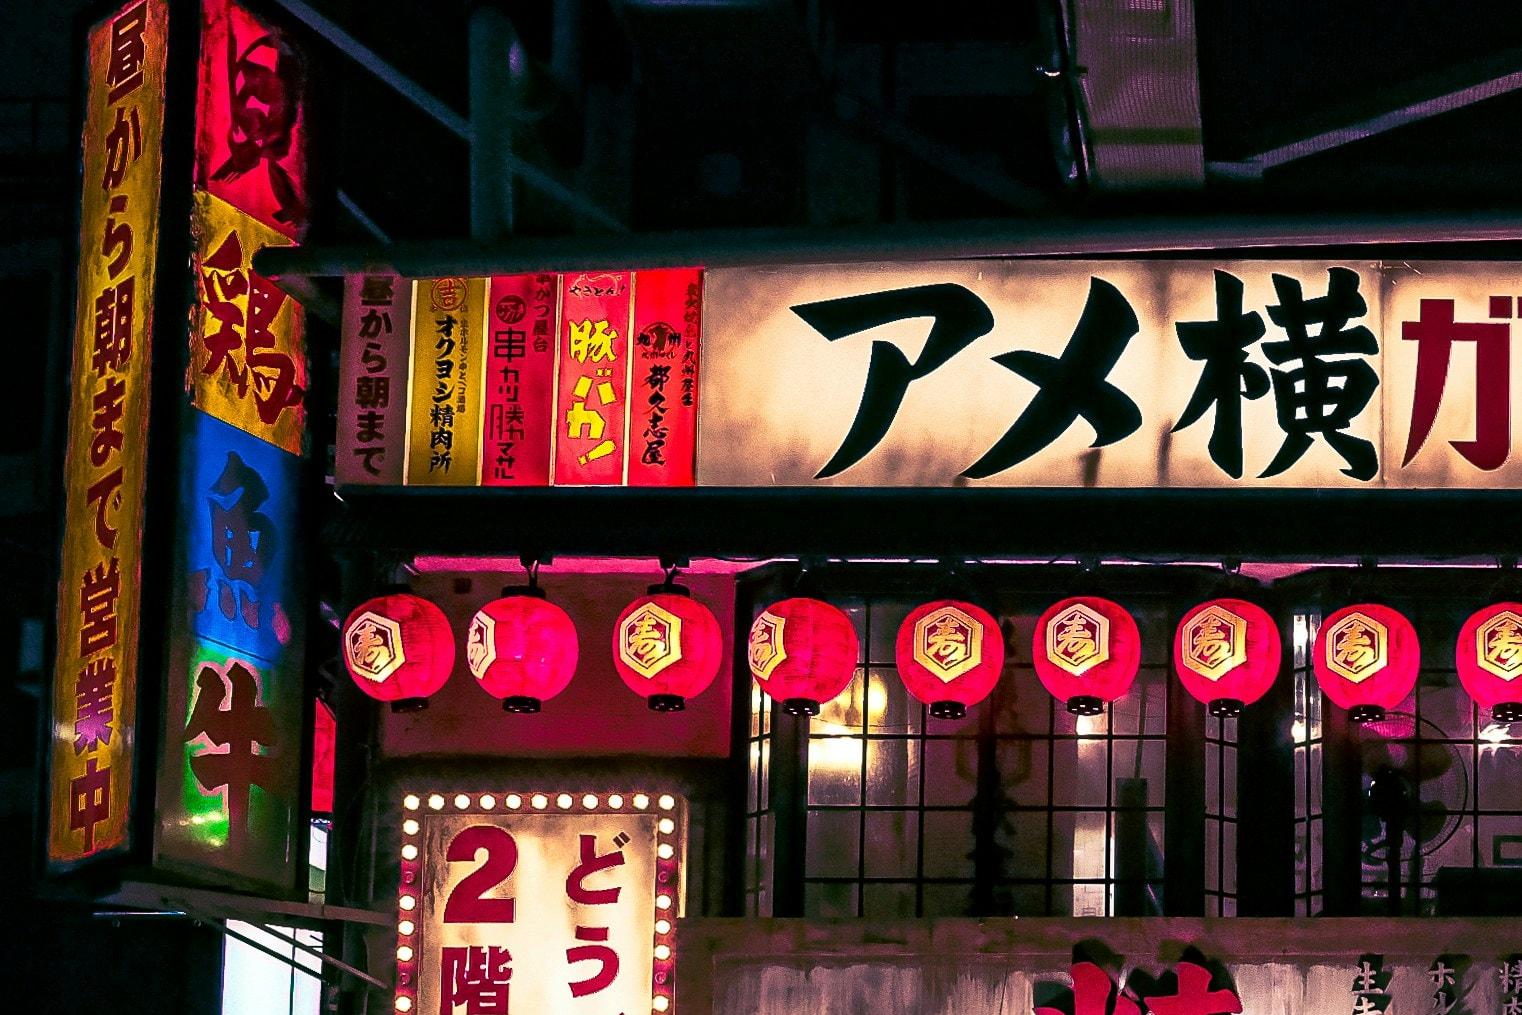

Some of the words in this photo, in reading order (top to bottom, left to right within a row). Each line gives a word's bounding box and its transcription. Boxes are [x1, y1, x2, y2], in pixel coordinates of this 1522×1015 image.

[211, 30, 304, 224] 貝
[202, 231, 302, 423] 鶏
[354, 277, 394, 476] 昼から朝まで
[430, 315, 460, 474] オクヨシ精肉所
[641, 363, 672, 466] 都久志屋
[68, 2, 146, 854] 昼から朝まで営業中
[190, 453, 290, 647] 魚
[184, 661, 279, 851] 牛
